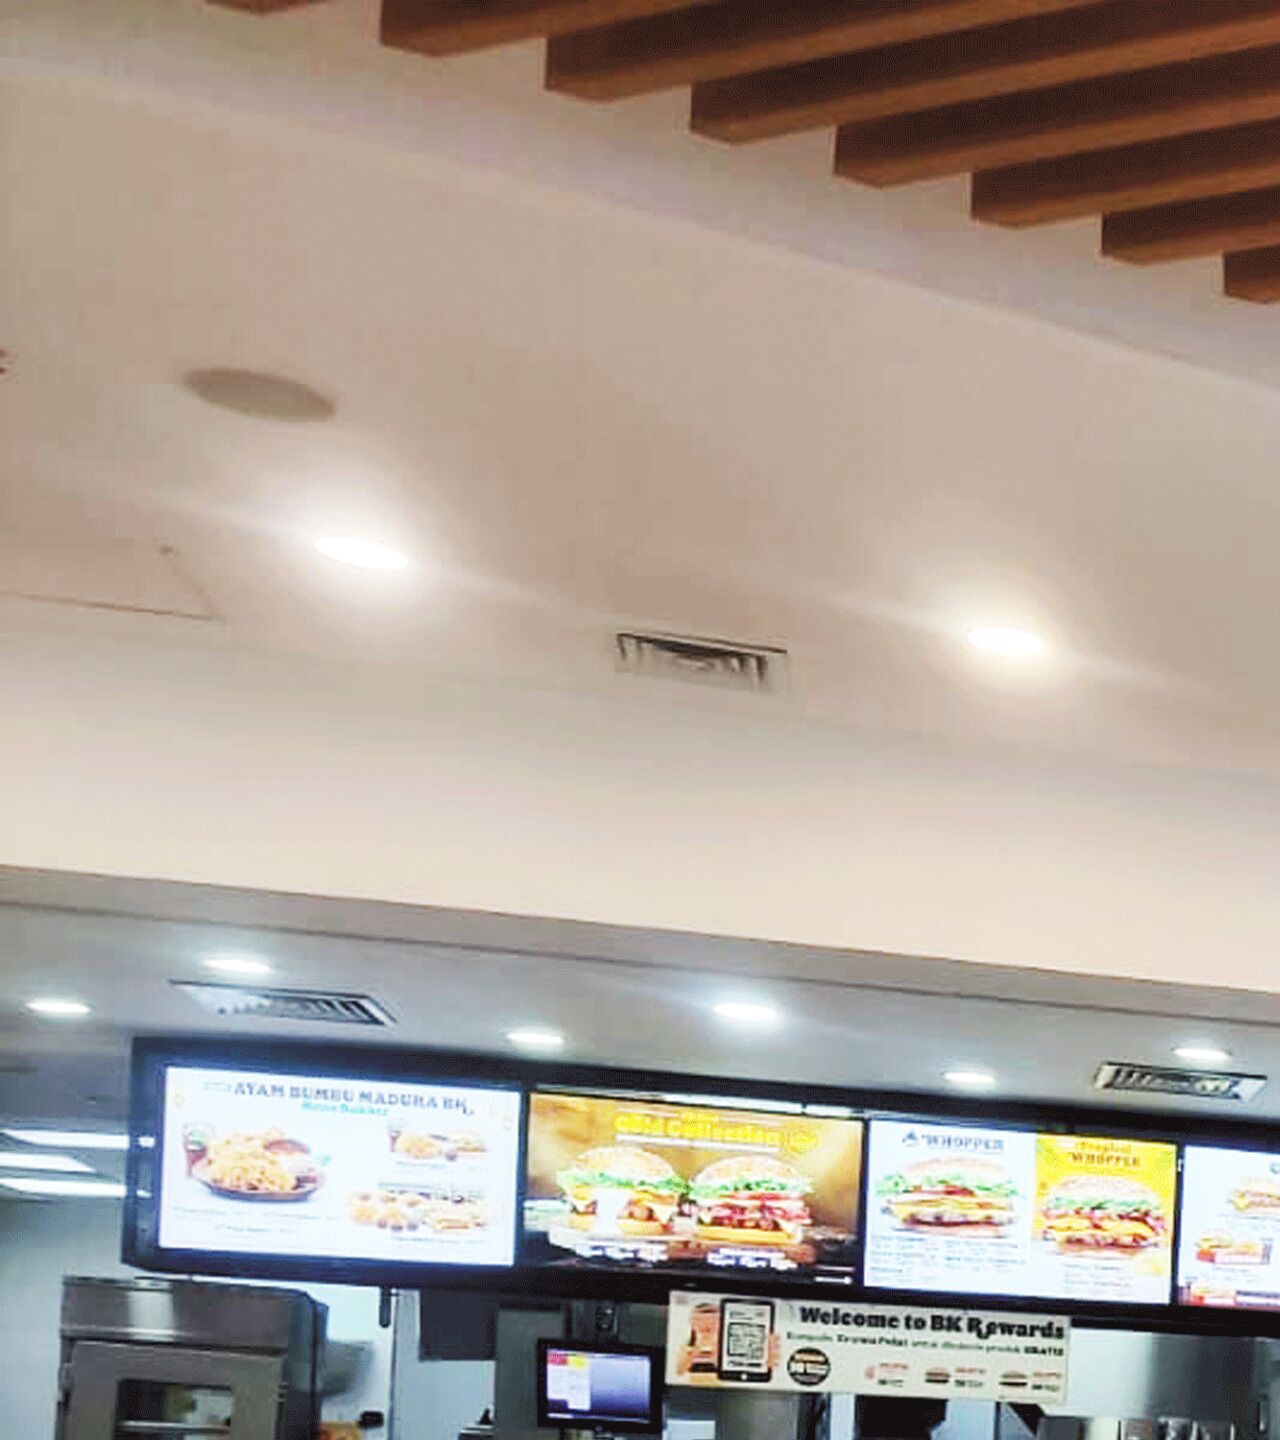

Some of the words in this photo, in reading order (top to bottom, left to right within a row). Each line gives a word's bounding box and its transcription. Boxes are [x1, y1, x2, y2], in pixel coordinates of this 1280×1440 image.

[233, 1081, 285, 1098] AYAM
[800, 1305, 898, 1329] Welcome
[904, 1313, 926, 1331] to
[930, 1315, 962, 1333] BK
[966, 1317, 1064, 1340] Rewards
